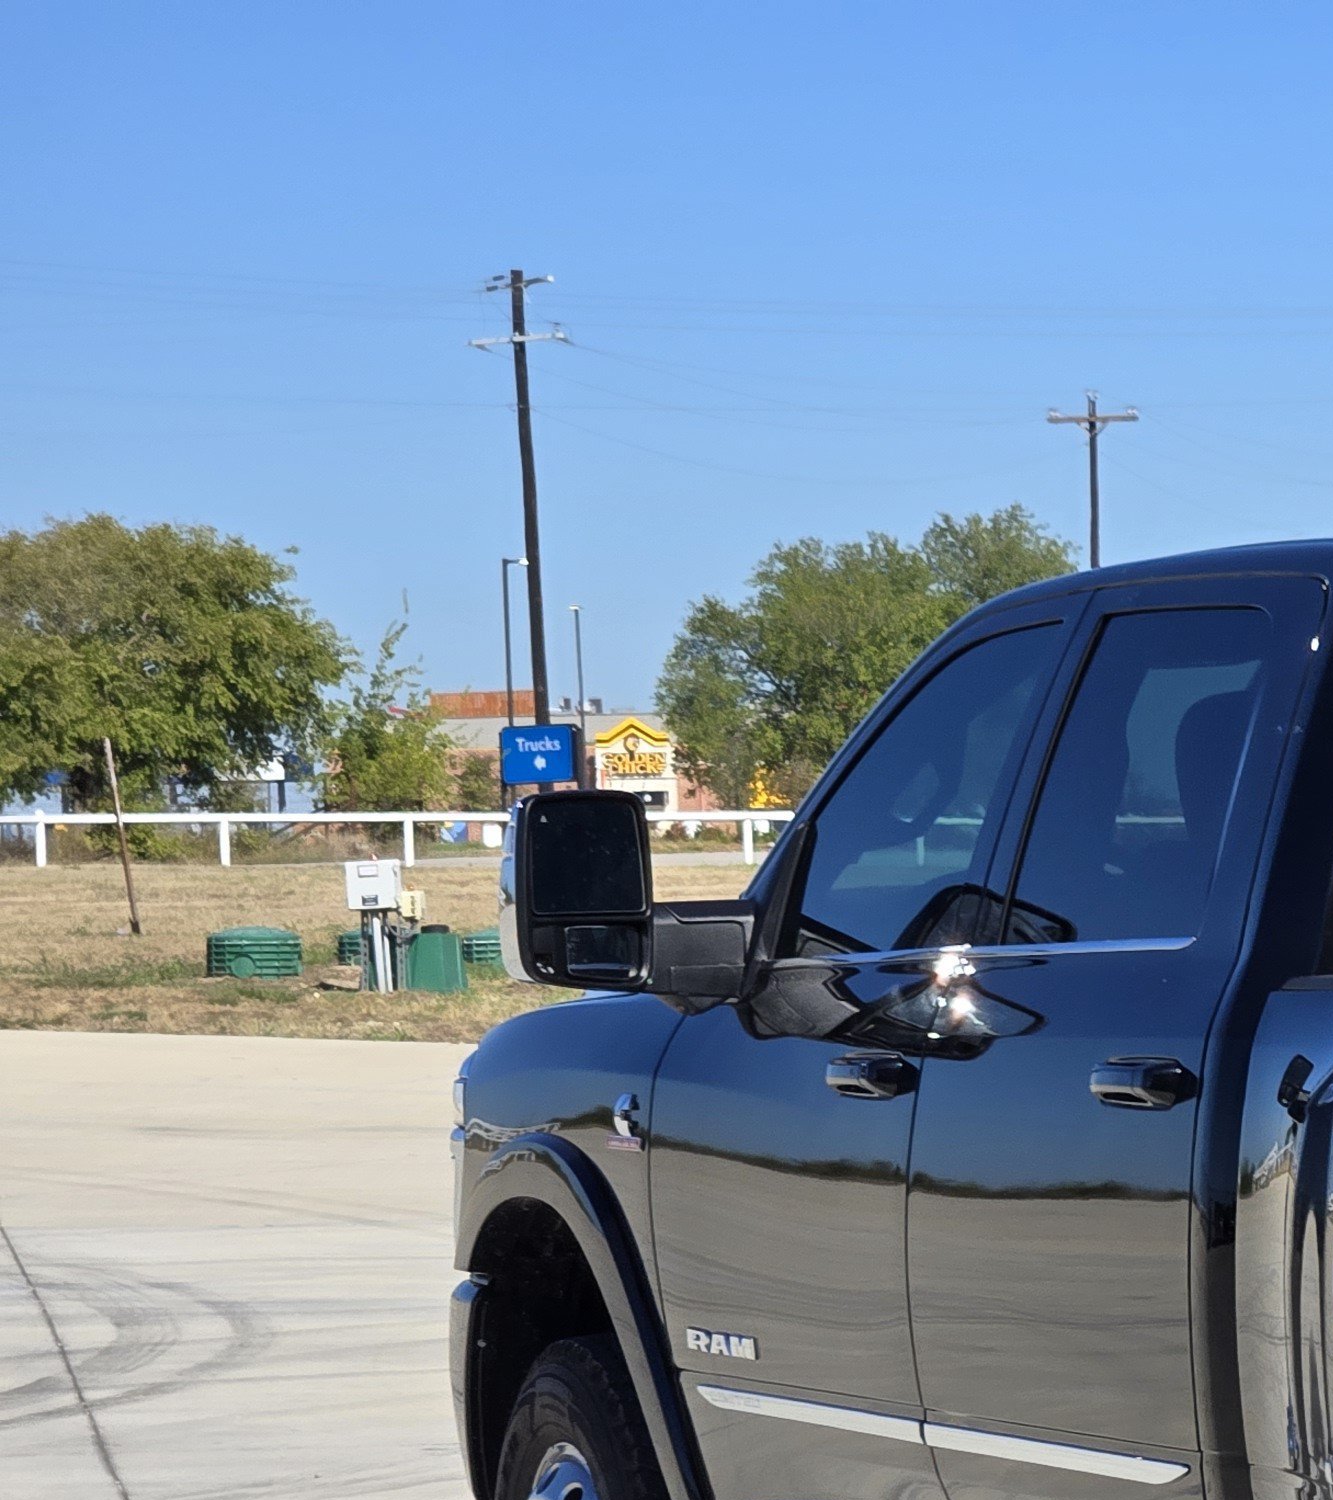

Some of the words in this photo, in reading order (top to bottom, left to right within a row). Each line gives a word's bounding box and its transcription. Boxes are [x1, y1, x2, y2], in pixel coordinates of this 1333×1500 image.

[515, 736, 561, 753] Trucks
[604, 753, 666, 765] GOLDEN
[609, 762, 660, 774] CHICK
[686, 1327, 758, 1361] RAM
